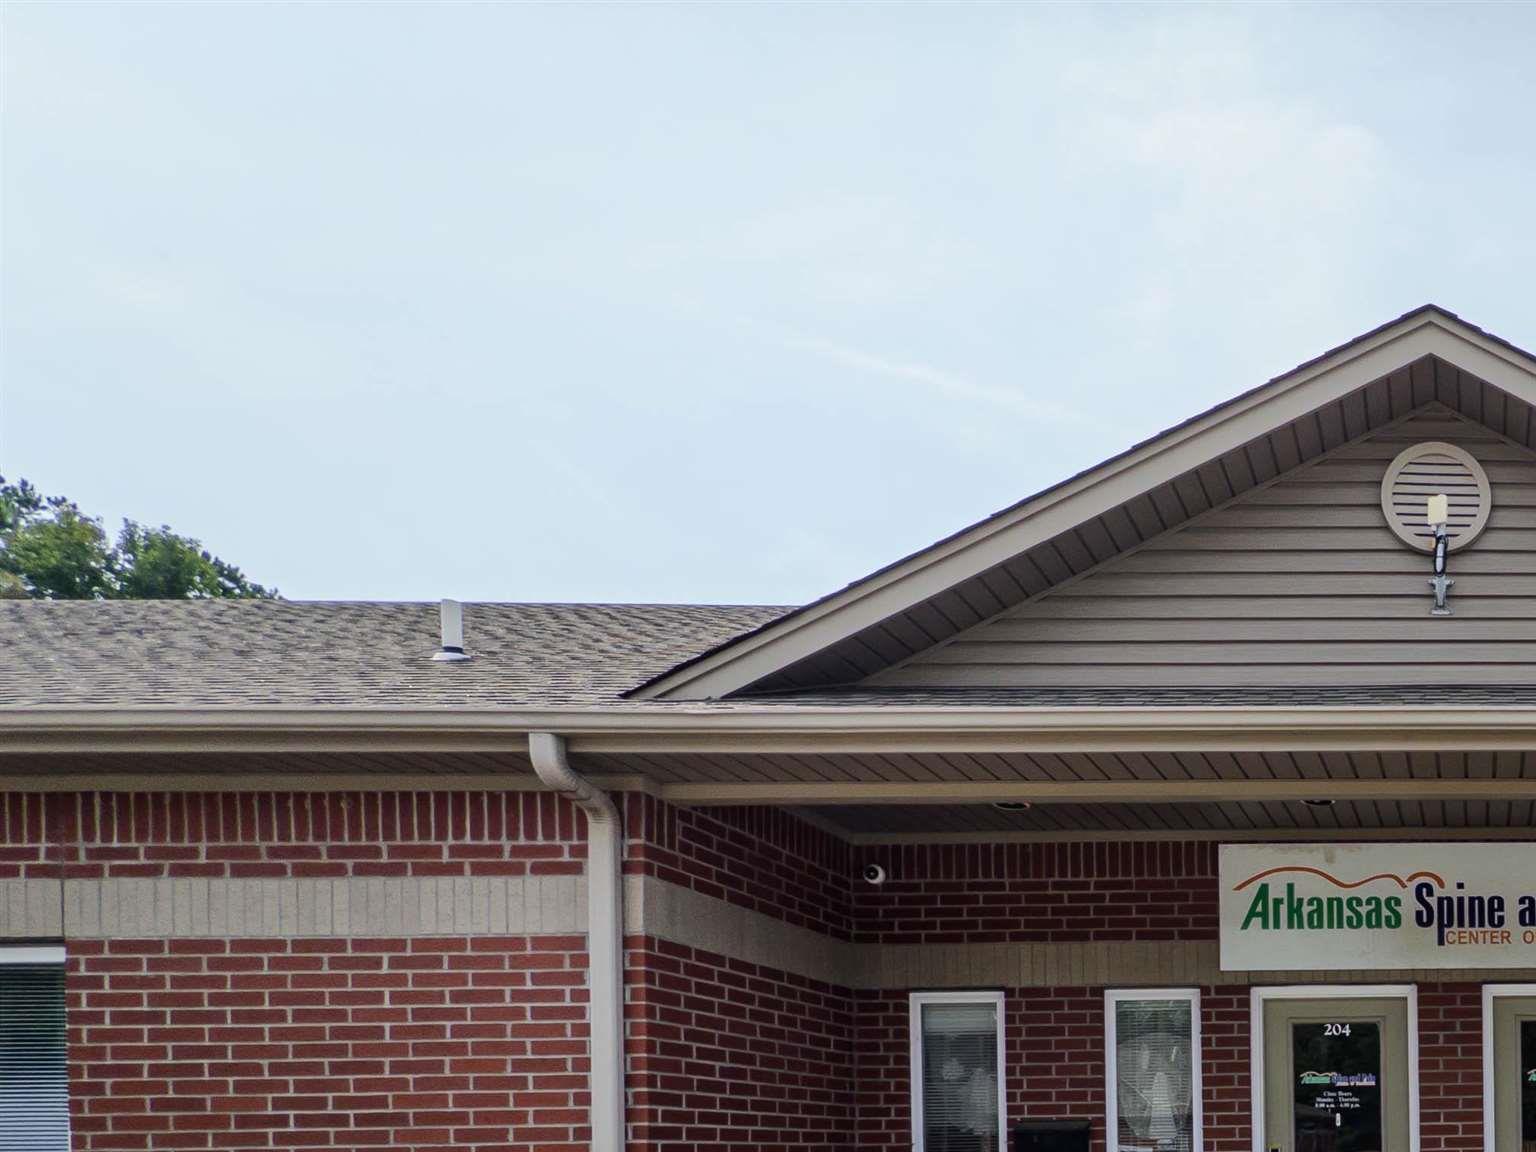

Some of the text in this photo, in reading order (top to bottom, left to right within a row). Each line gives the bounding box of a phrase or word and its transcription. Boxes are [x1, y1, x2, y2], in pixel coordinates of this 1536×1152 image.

[1240, 882, 1402, 930] Arkansas
[1414, 881, 1505, 946] Spine
[1445, 930, 1512, 945] CENTER
[1323, 1023, 1351, 1036] 204
